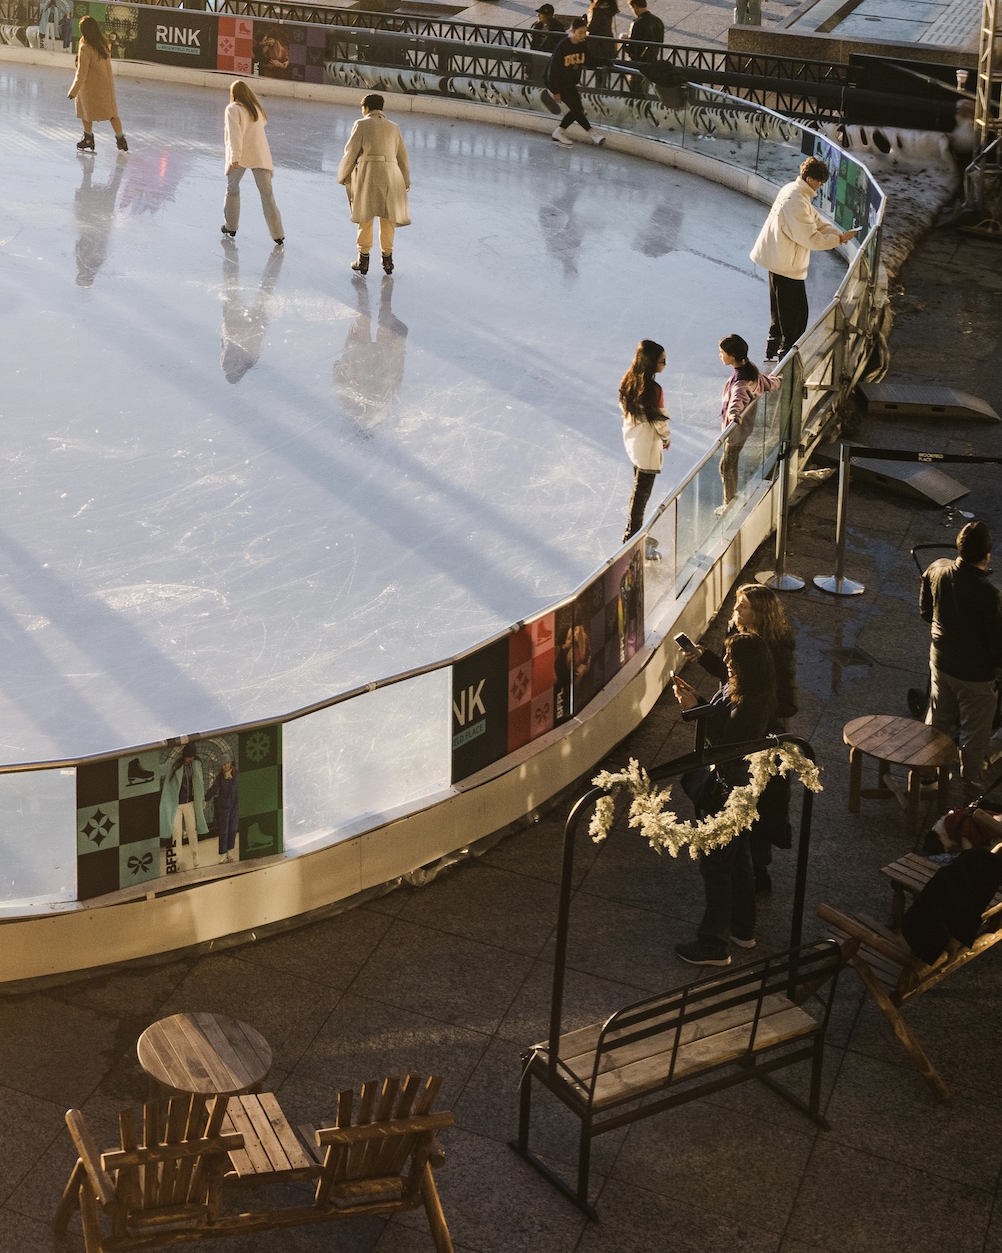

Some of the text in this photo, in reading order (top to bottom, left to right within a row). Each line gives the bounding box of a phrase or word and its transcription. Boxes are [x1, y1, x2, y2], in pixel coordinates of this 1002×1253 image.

[156, 25, 201, 47] RINK
[556, 687, 564, 720] BFPL
[466, 723, 484, 739] PLACE
[166, 839, 177, 875] BFPL
